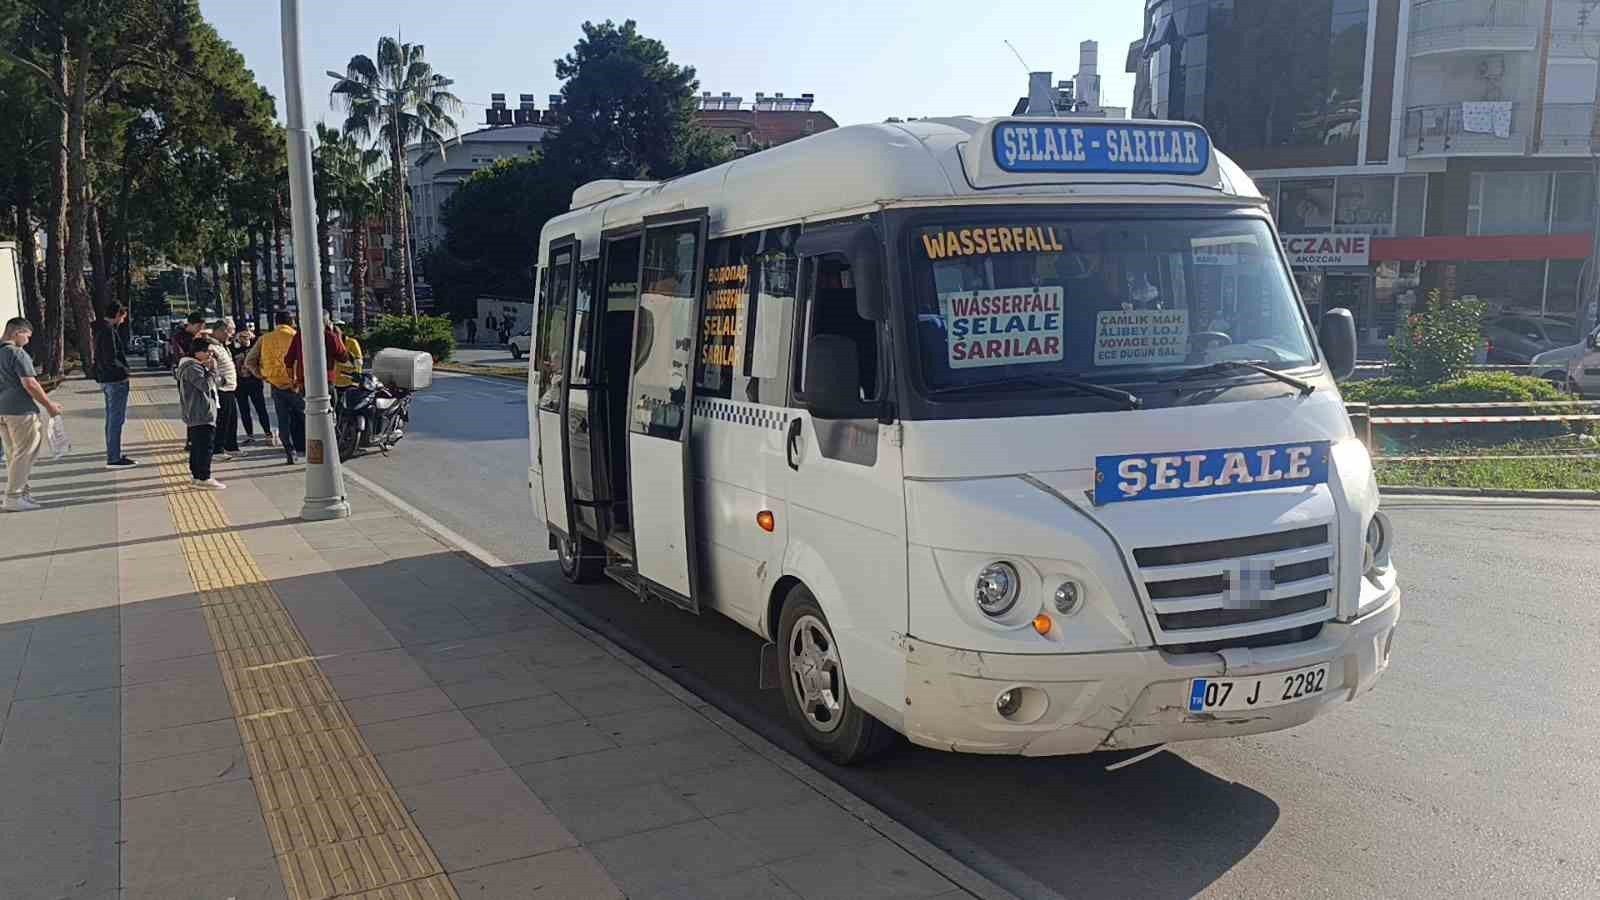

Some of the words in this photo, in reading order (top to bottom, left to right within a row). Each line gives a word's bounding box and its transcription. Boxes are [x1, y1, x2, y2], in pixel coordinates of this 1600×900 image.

[1003, 127, 1086, 166] ŞELALE
[1106, 129, 1199, 164] SARILAR
[922, 226, 1063, 259] WASSERFALL
[951, 293, 1061, 317] WASSERFALL
[703, 314, 744, 342] ŞELALE
[951, 312, 1060, 341] ŞELALE
[951, 336, 1060, 361] SARILAR
[1099, 336, 1150, 348] VOYAGE
[1117, 446, 1313, 498] ŞELALE
[1205, 682, 1233, 708] 07
[1246, 681, 1261, 705] J
[1281, 668, 1326, 701] 2282
